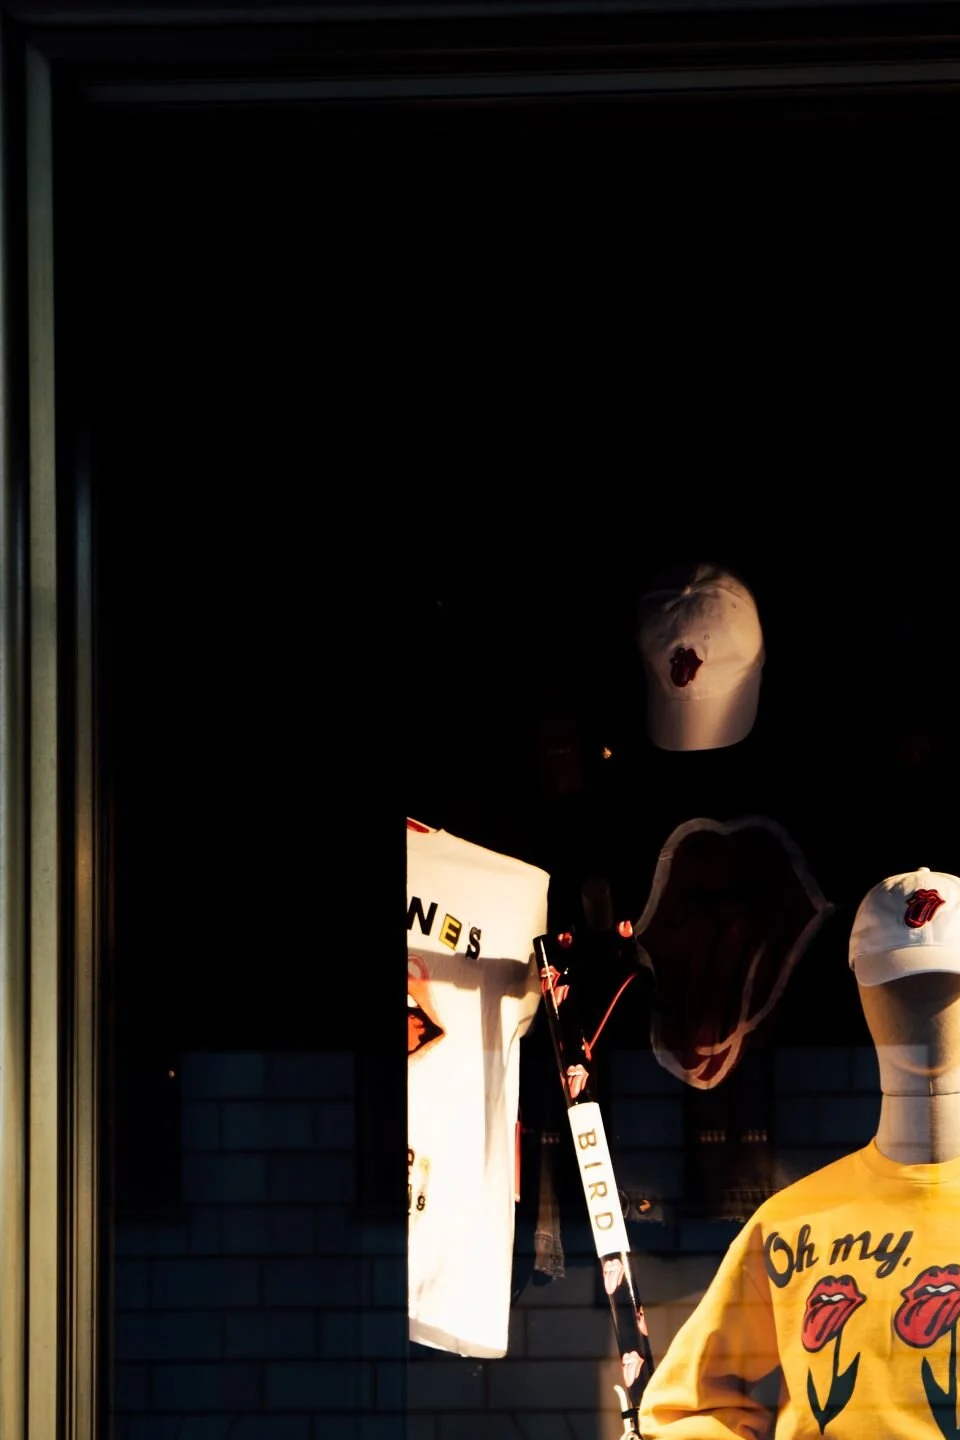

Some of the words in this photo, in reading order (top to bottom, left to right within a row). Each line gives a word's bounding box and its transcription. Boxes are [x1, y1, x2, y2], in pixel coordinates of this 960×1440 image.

[577, 1128, 614, 1231] BIRD
[764, 1224, 819, 1288] Oh
[829, 1231, 914, 1279] my,
